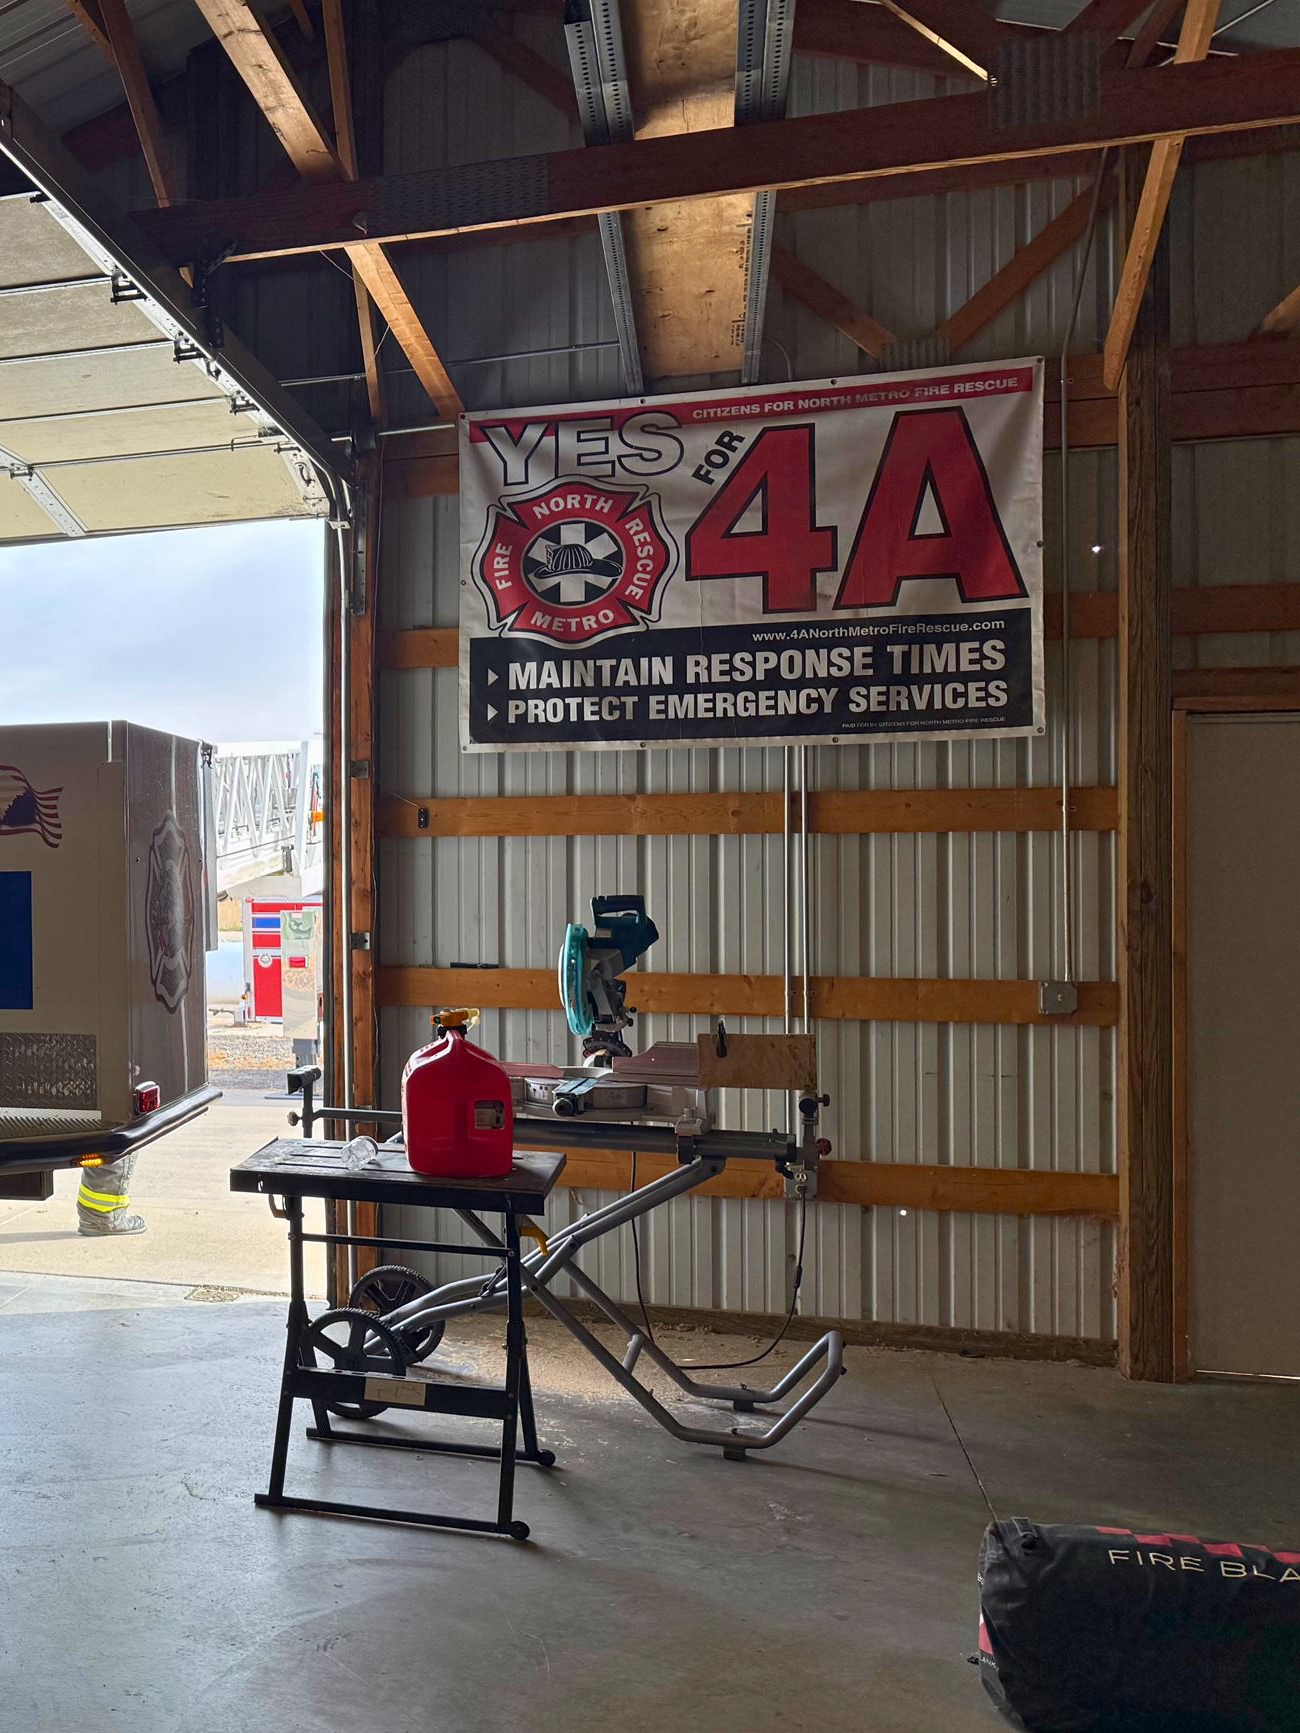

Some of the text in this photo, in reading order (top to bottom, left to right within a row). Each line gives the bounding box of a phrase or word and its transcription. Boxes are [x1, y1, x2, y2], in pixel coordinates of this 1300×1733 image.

[692, 377, 1018, 420] CITIZENS FOR NORTH METRO FIRE RESCUE
[480, 406, 1030, 614] YES FOR 4A
[532, 494, 614, 520] NORTH
[493, 542, 513, 591] FIRE
[624, 518, 654, 600] RESCUE
[530, 609, 614, 632] METRO
[752, 619, 1005, 642] www.4ANorthMetroFireRescue.com
[508, 639, 1006, 691] MAINTAIN RESPONSE TIMES
[507, 680, 1008, 724] PROTECT EMERGENCY SERVICES
[1108, 1549, 1300, 1583] FIRE BLA
